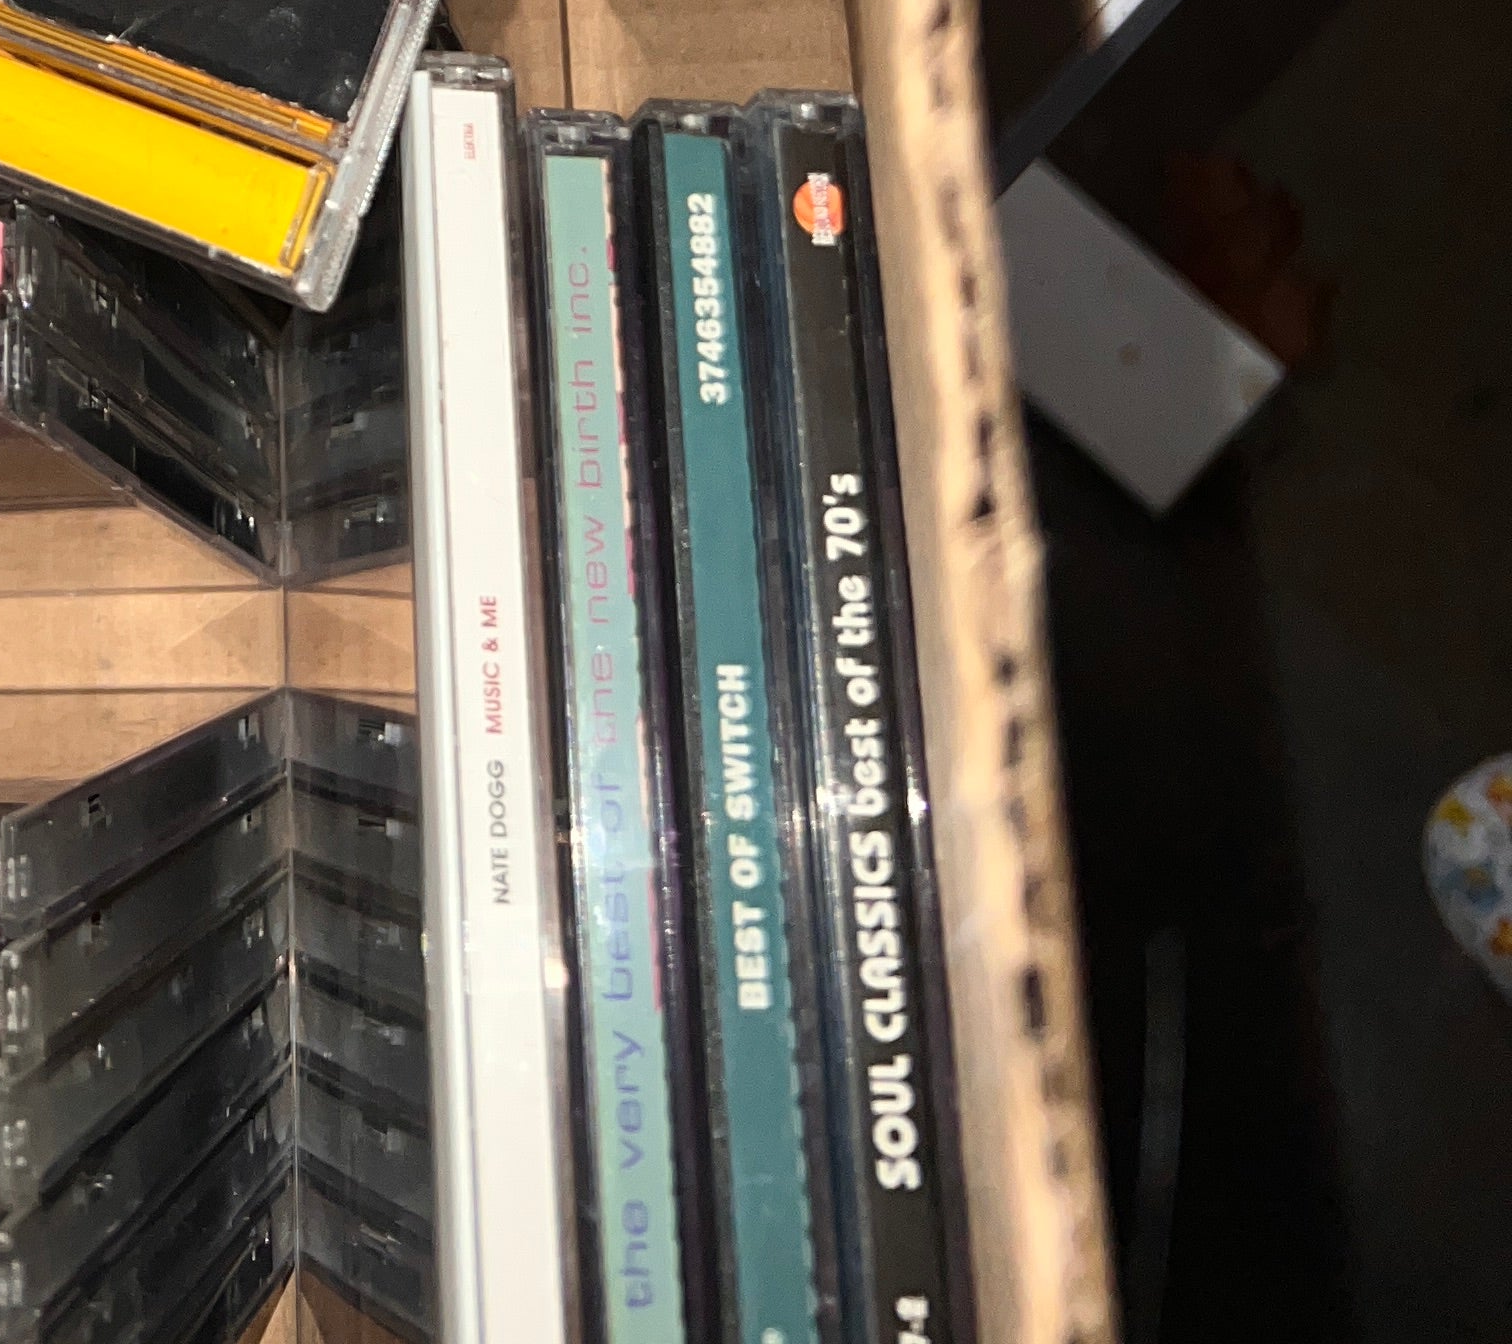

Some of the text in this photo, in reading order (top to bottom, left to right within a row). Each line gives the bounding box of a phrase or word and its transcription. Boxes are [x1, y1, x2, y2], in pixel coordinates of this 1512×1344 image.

[480, 593, 512, 906] NATE DOGG MUSIC ME
[564, 244, 645, 1170] very best new birth inc.
[716, 664, 774, 1011] BEST OF SWITCH
[831, 574, 921, 1192] SOUL CLASSICS best of the
